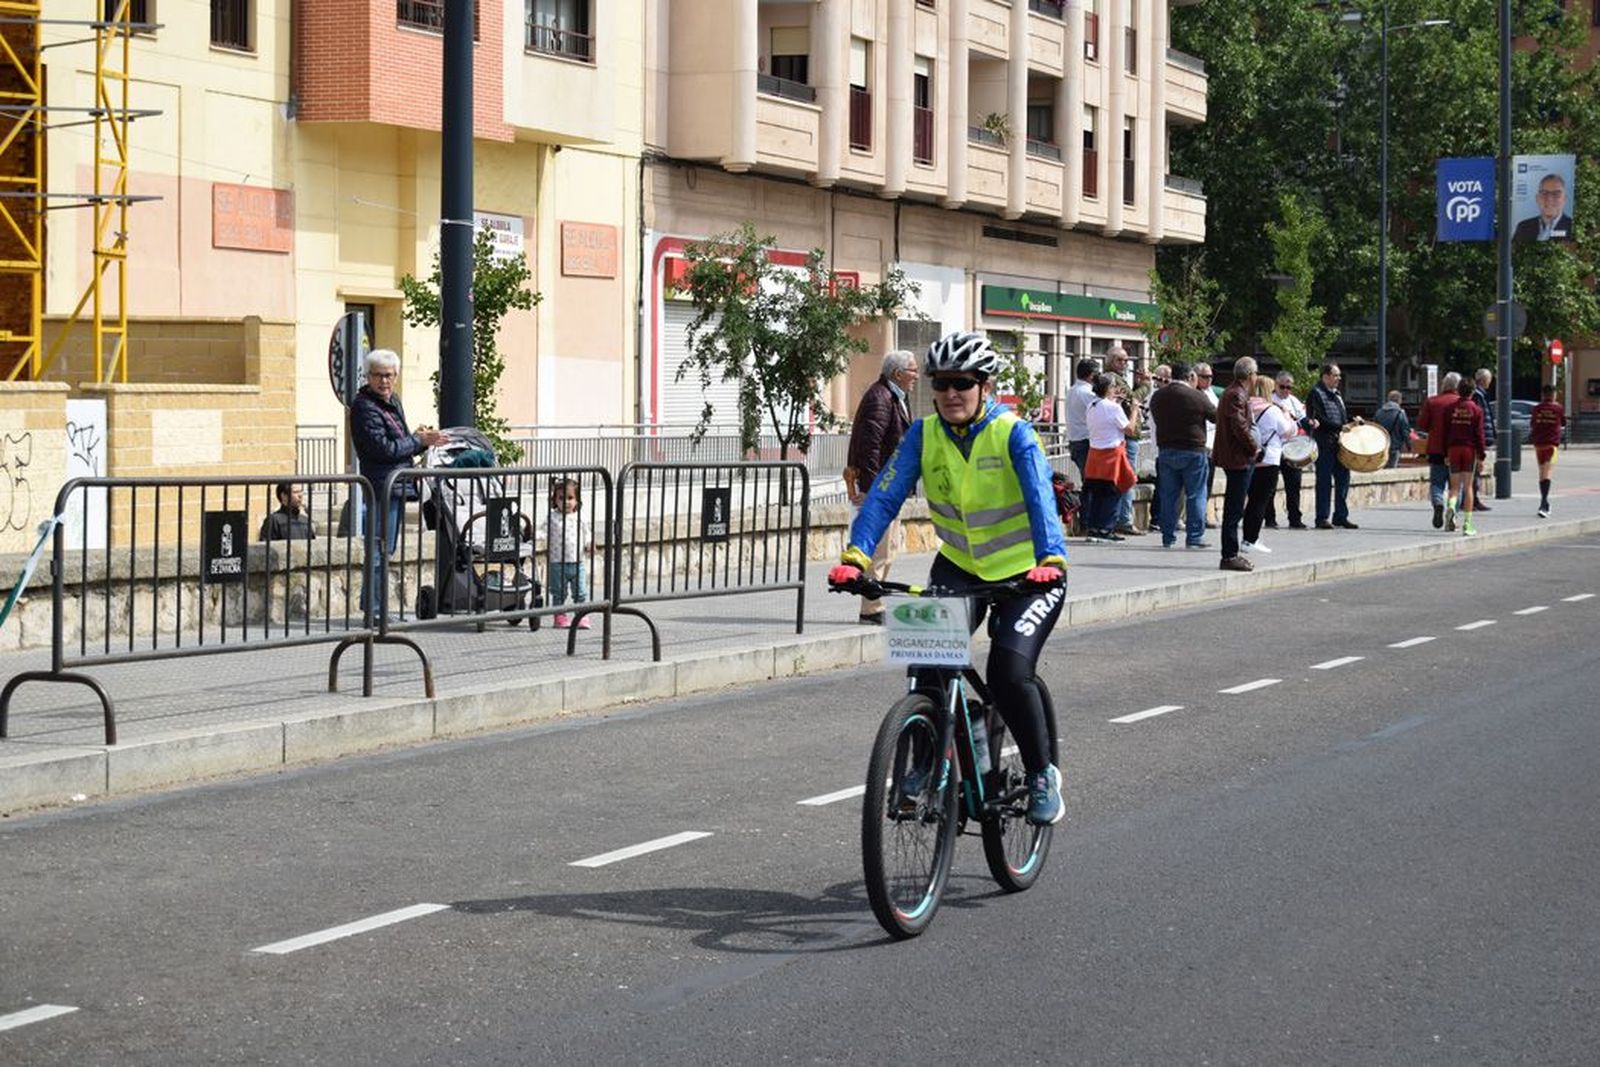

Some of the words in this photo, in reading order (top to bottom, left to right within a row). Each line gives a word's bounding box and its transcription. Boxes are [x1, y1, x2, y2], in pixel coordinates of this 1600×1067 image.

[1448, 180, 1482, 193] VOTA
[890, 650, 932, 659] PRIMERAS
[934, 650, 964, 659] DAMAS
